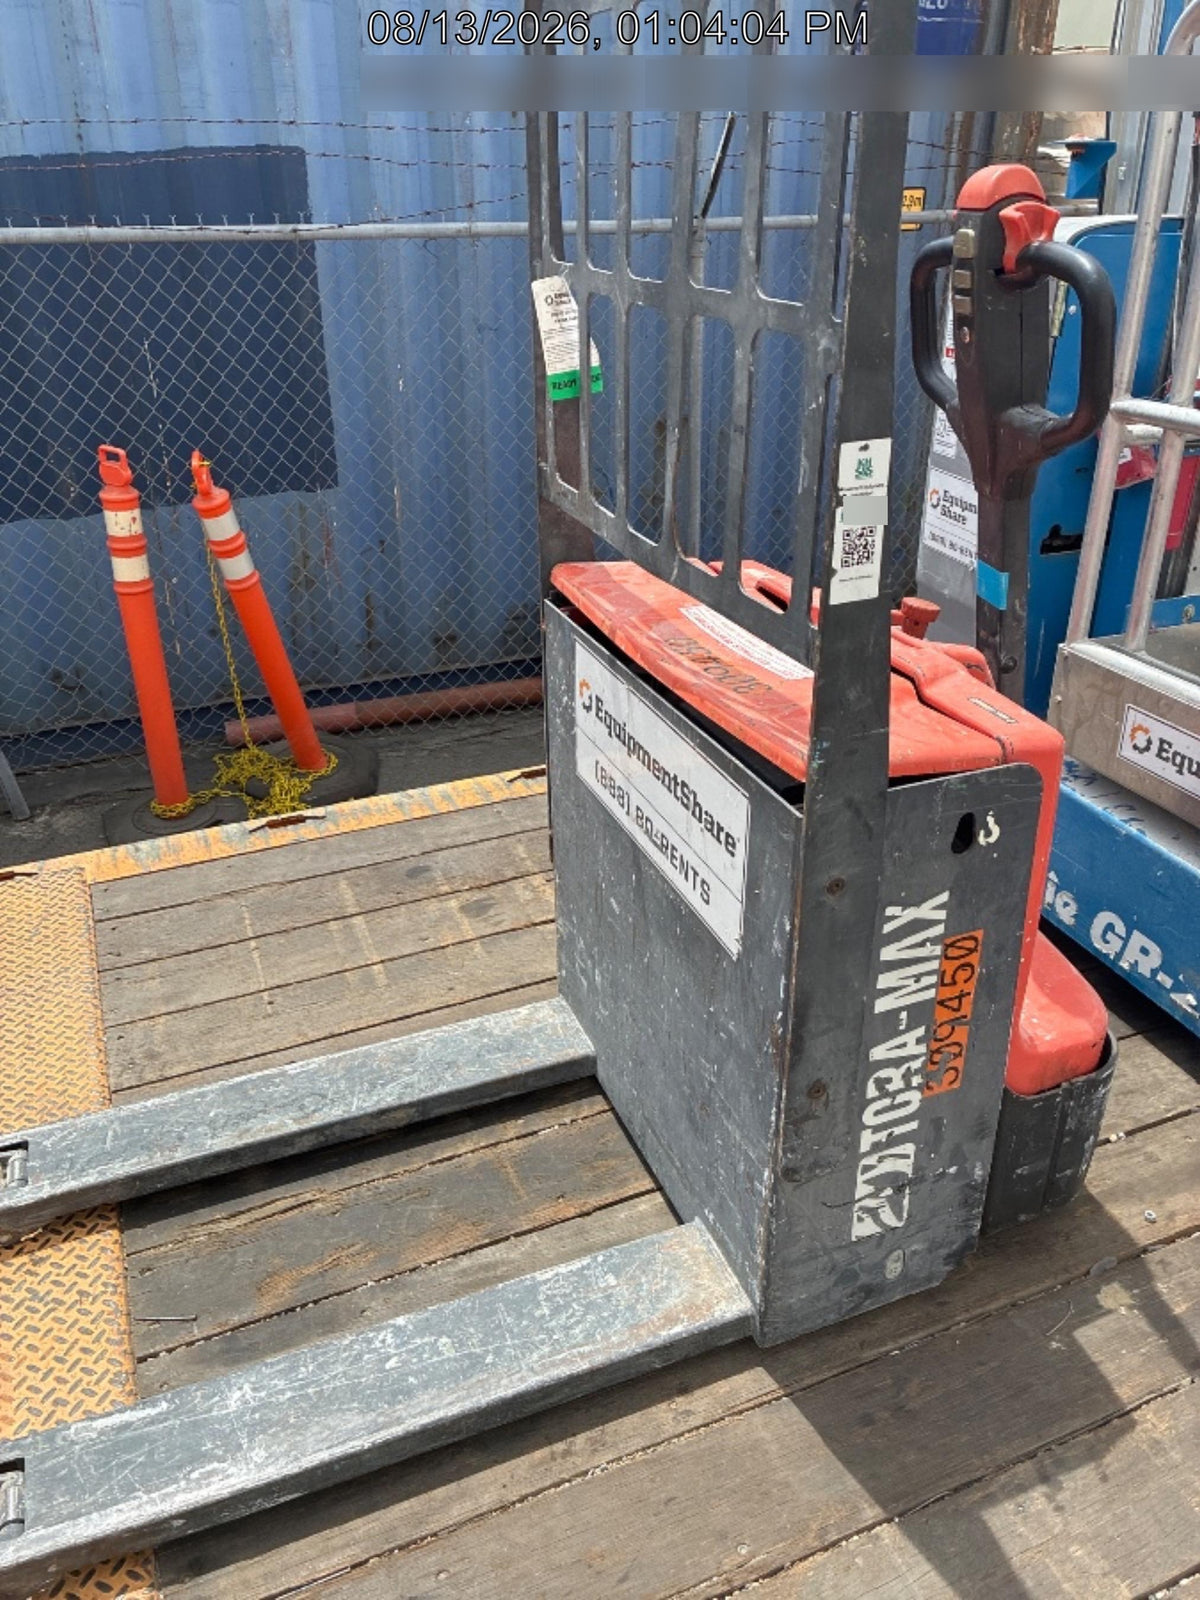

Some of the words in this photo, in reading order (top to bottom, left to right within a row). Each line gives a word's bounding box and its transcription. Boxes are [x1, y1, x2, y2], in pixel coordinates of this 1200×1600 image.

[940, 504, 967, 525] Share
[595, 693, 738, 858] EquipmentShare
[1155, 737, 1200, 780] Equ
